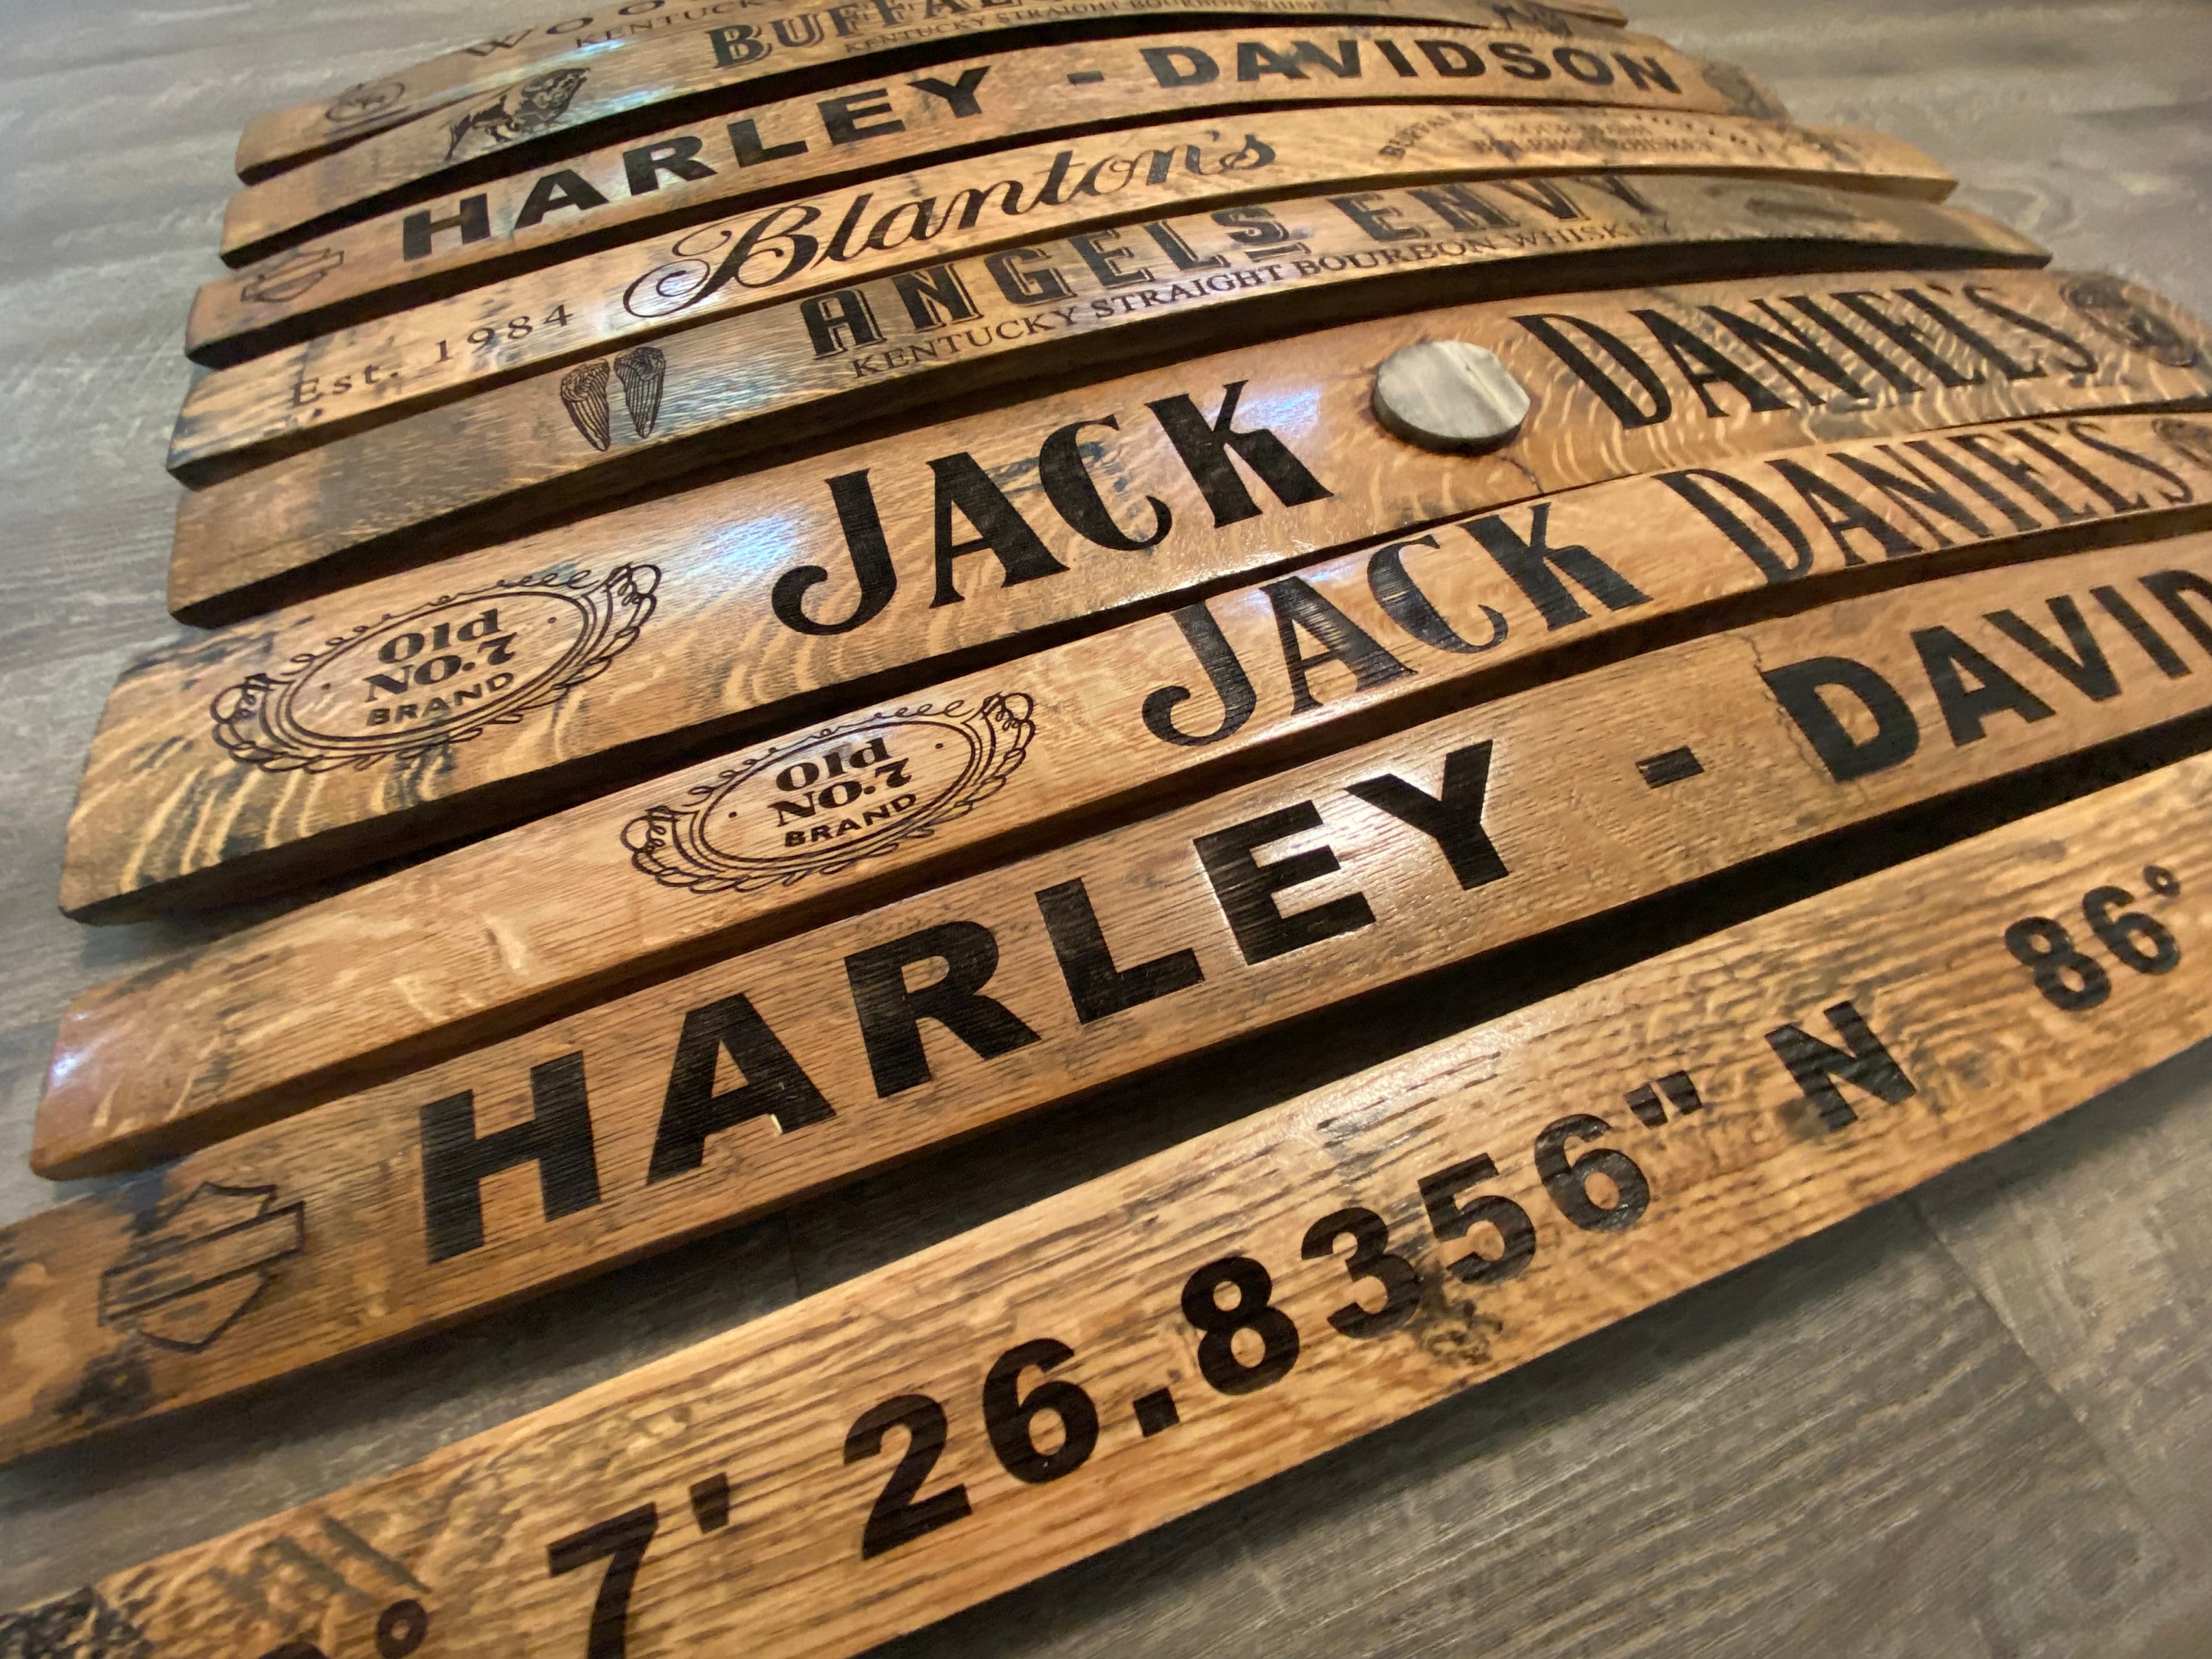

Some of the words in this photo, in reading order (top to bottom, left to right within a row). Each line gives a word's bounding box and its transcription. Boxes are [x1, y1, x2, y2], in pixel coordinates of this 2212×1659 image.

[844, 16, 986, 53] KENTUCKY
[402, 65, 991, 262] HARLEY
[1140, 38, 1683, 94] DAVIDSON
[622, 130, 1277, 319] Blanton's
[799, 206, 1312, 361] ANGELS
[1326, 175, 1669, 243] ENVY
[852, 305, 1079, 378] KENTUCKY
[1091, 263, 1284, 320] STRAIGHT
[1292, 236, 1500, 276] BOURBON
[291, 363, 401, 408] Est.
[435, 303, 574, 364] 1984
[771, 379, 1335, 636] JACK
[1509, 282, 2098, 430] DANIEL'S
[378, 608, 502, 664] Old
[1141, 501, 1655, 746] JACK
[1649, 419, 2194, 585] DANIEL'S
[366, 672, 515, 726] BRAND
[775, 737, 892, 792] Old
[784, 793, 917, 847] BRAND
[419, 739, 1510, 1265] HARLEY
[843, 1069, 1703, 1562] 26.8356"
[1764, 1001, 1916, 1133] N
